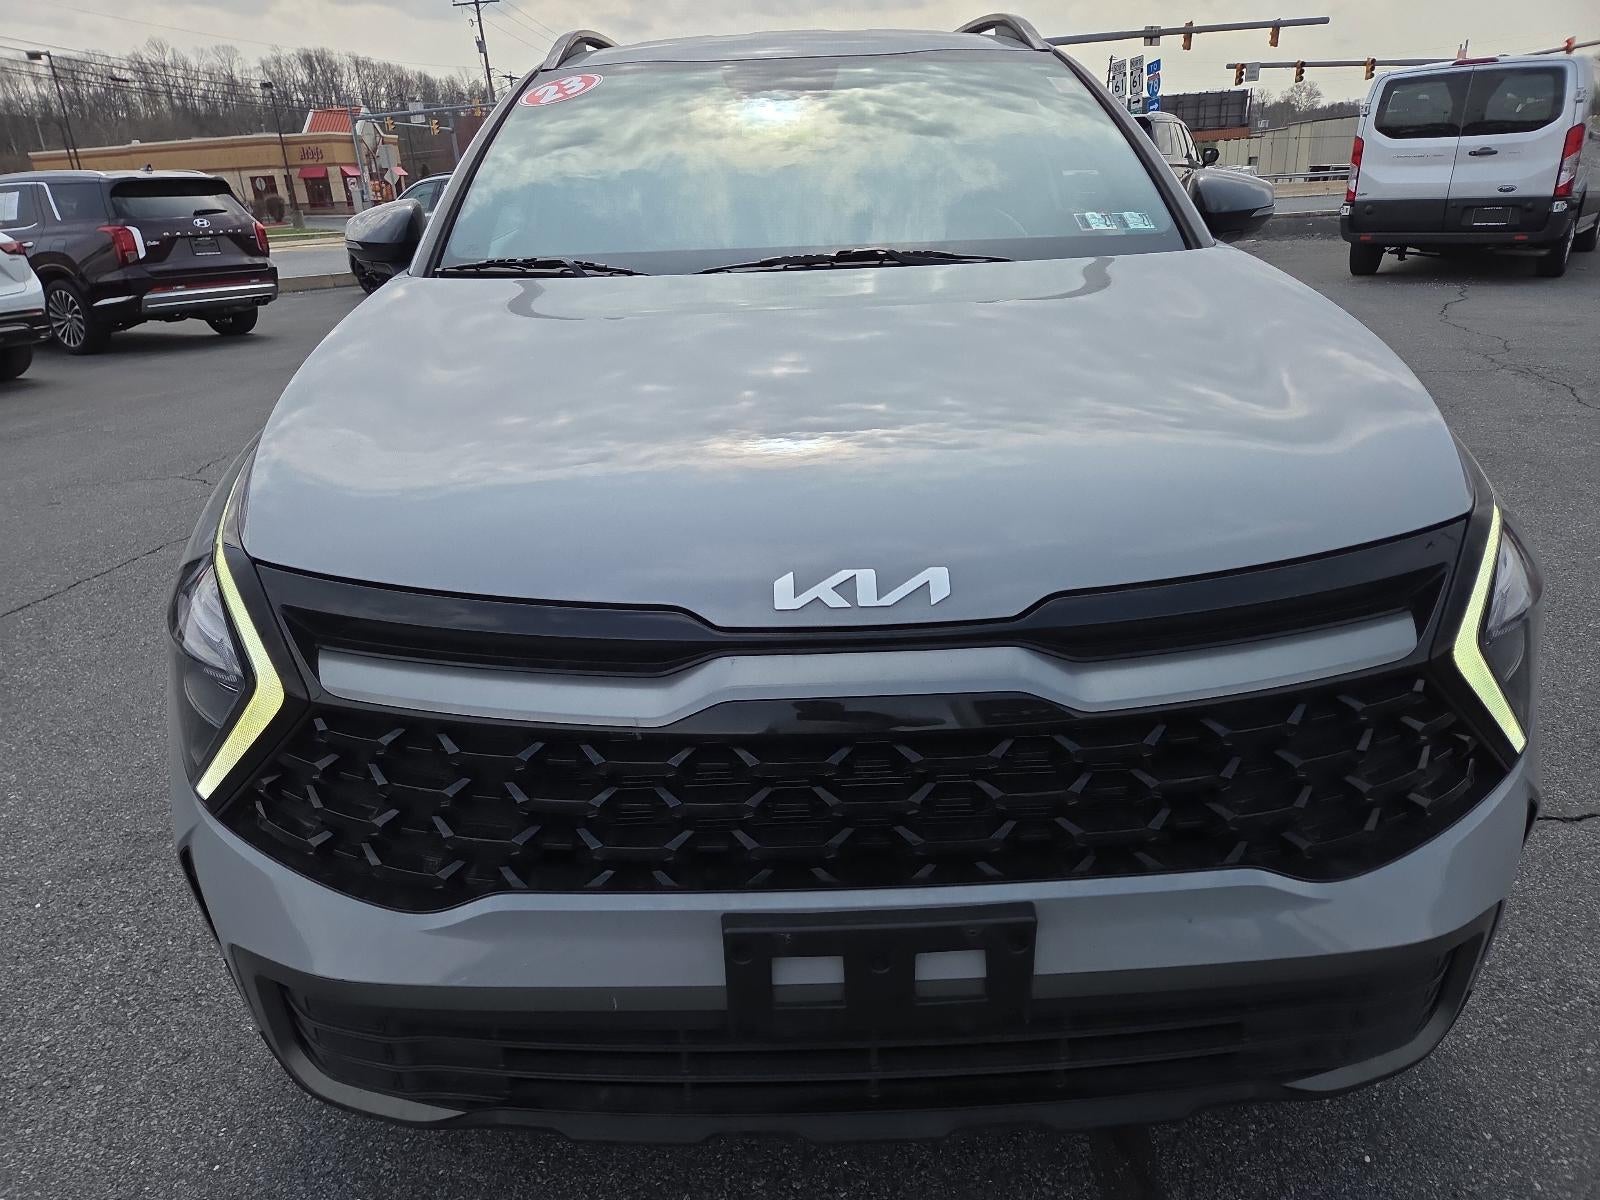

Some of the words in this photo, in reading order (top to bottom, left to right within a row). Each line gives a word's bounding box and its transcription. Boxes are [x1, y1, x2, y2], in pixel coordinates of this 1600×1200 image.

[1150, 63, 1158, 72] TO
[1114, 79, 1124, 92] 61
[1132, 74, 1141, 88] 61
[1149, 80, 1159, 95] 78
[535, 76, 586, 104] 23
[774, 566, 950, 610] KIA
